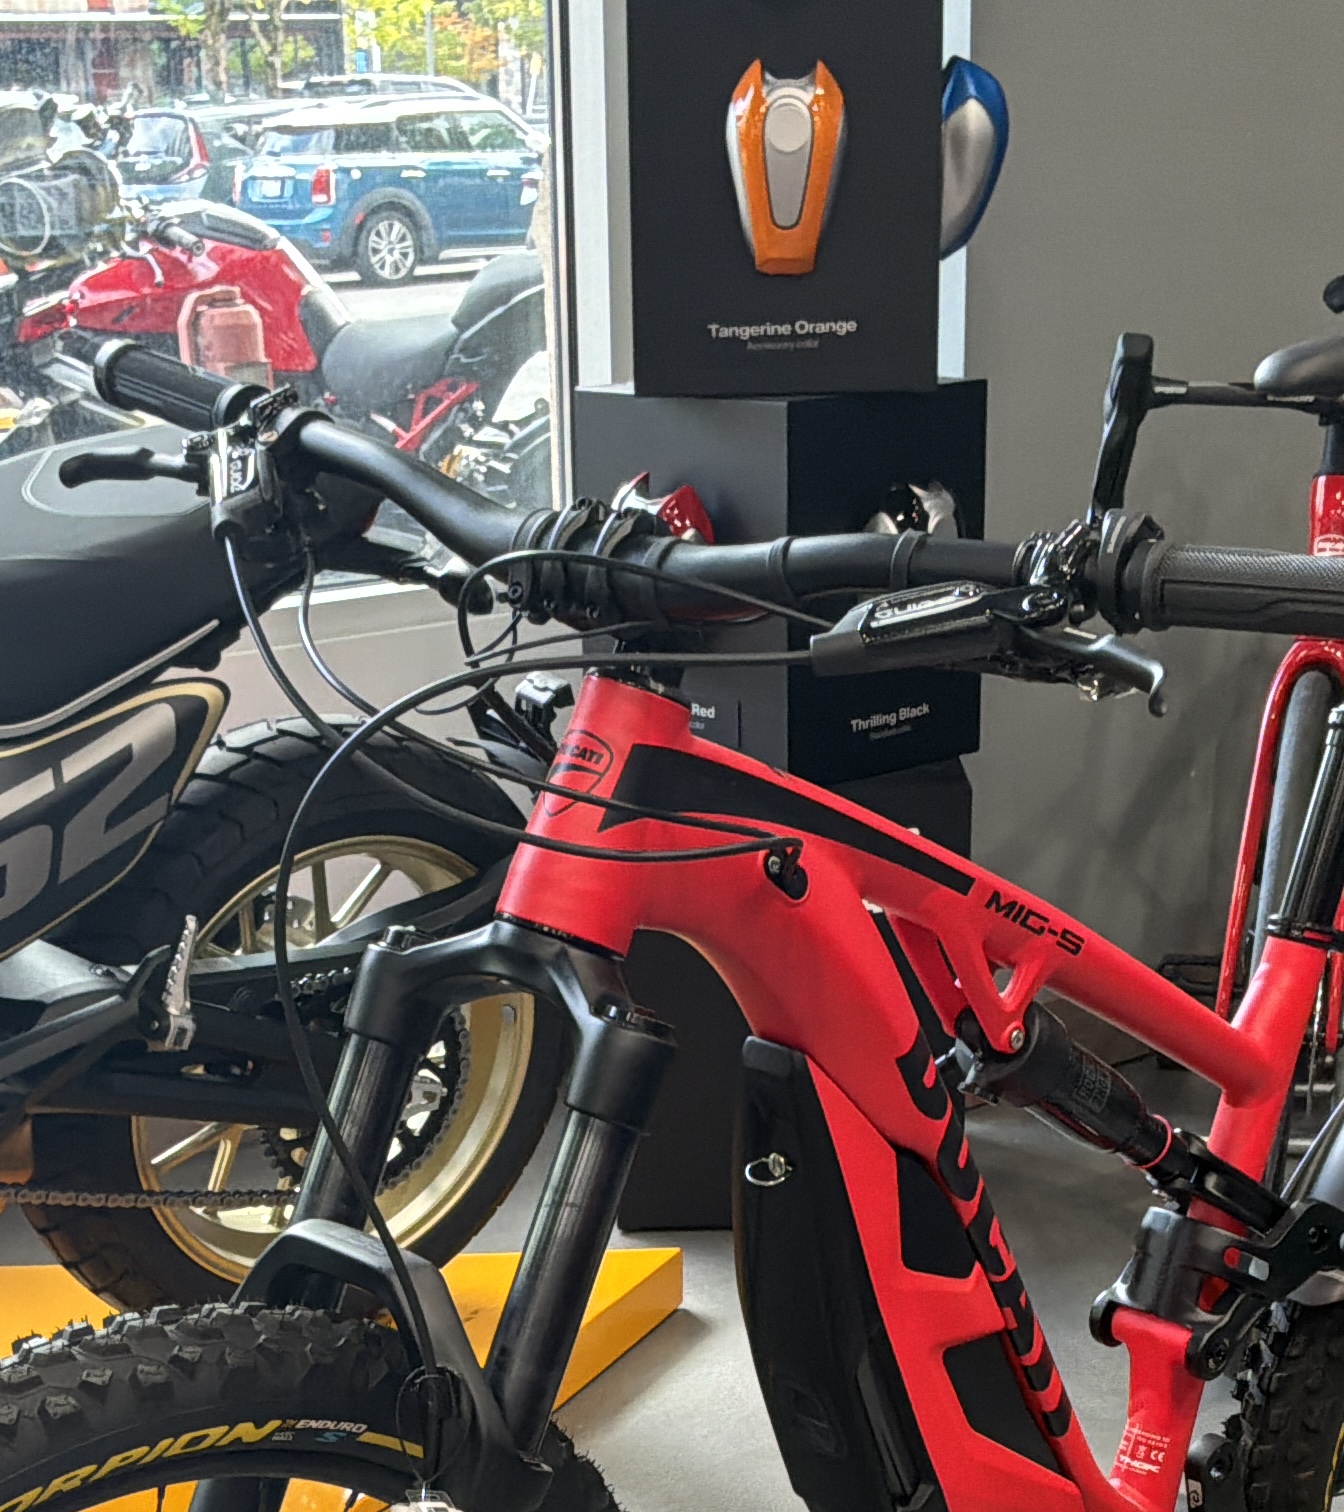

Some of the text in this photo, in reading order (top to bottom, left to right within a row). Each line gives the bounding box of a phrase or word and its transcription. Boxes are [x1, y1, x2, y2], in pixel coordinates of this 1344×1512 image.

[707, 319, 858, 340] Tangerine Orange
[690, 702, 716, 719] Red
[850, 711, 897, 733] Thrilling
[898, 702, 930, 721] Black
[984, 889, 1086, 956] MIG-S
[295, 1418, 369, 1434] ENDURO
